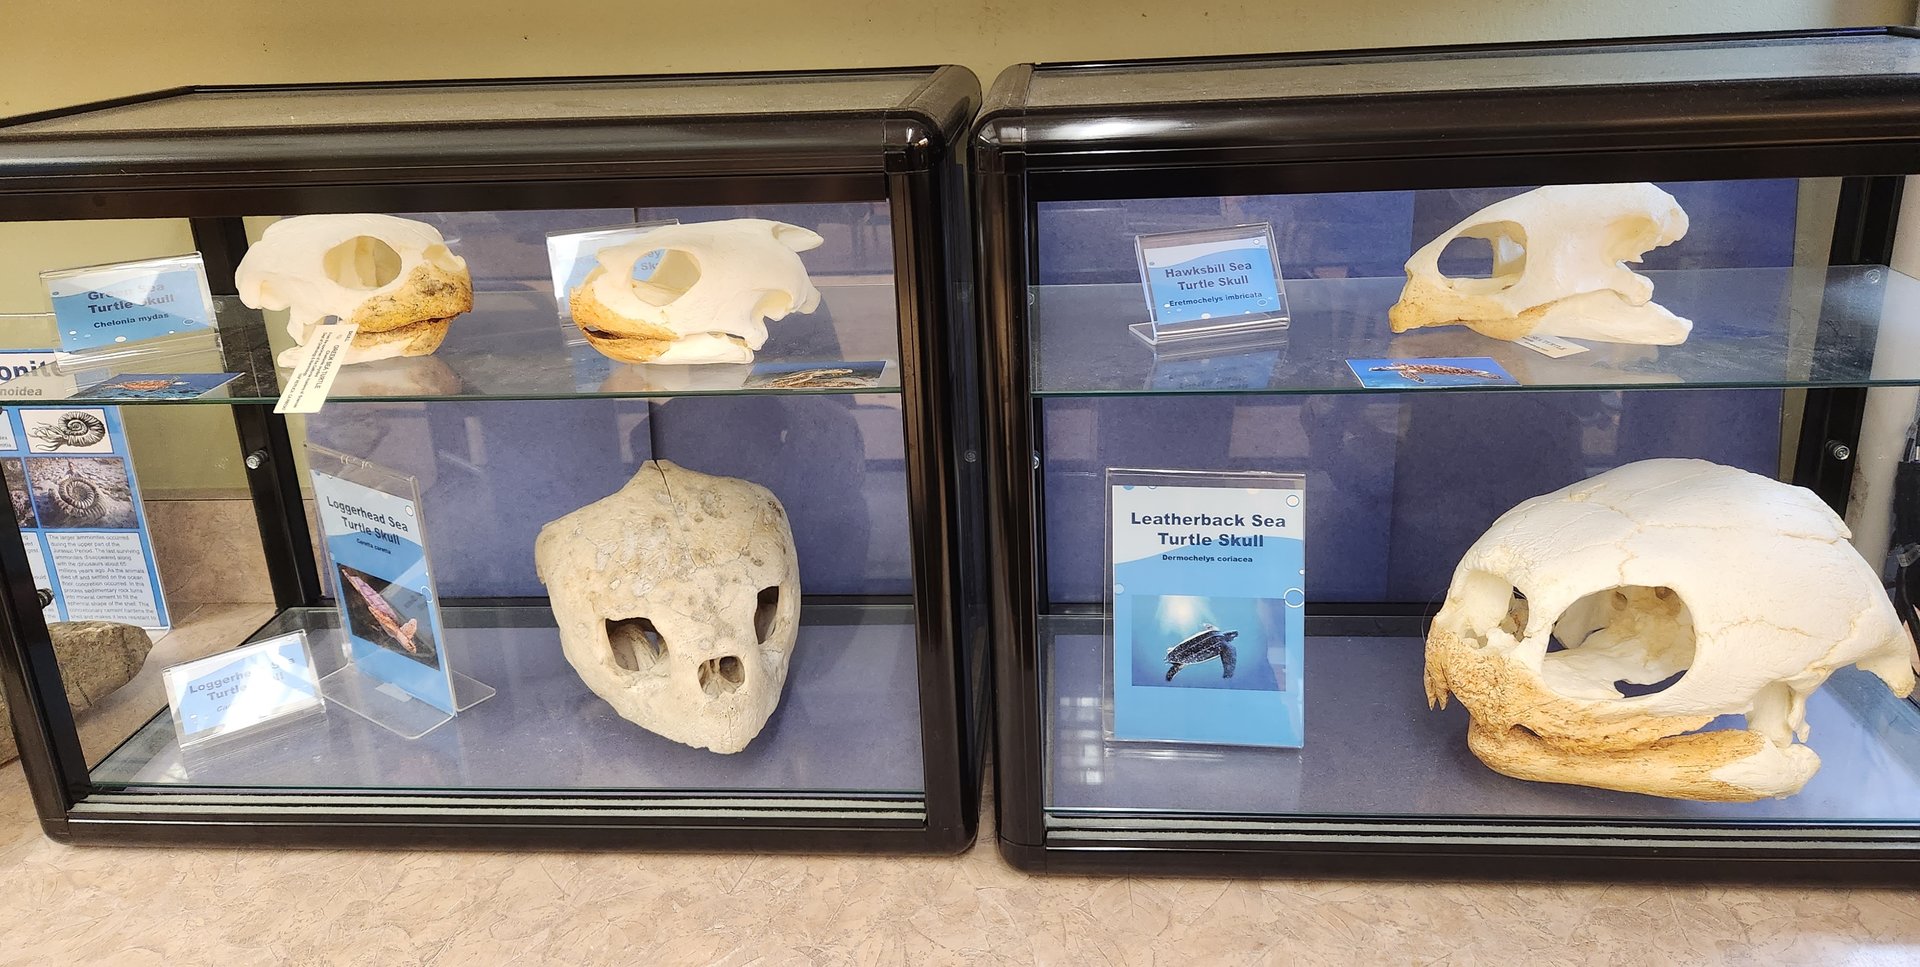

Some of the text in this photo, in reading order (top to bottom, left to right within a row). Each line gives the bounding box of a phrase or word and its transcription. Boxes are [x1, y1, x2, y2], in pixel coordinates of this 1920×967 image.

[1165, 262, 1252, 278] Hawksbill Sea
[1177, 275, 1249, 291] Turtle Skull
[88, 300, 133, 313] Turtle
[1169, 292, 1262, 307] Eretmochelys imbricata
[94, 313, 169, 328] Chelonia mydas
[0, 386, 42, 396] noidea
[327, 495, 408, 532] Loggerhead Sea
[1131, 512, 1286, 527] Leatherback Sea
[341, 516, 400, 545] Turtle Skull
[356, 538, 391, 554] Caretta caretta
[1157, 532, 1264, 547] Turtle Skull
[1162, 554, 1253, 563] Dermochelys coriacea
[189, 670, 251, 694] Loggerhe
